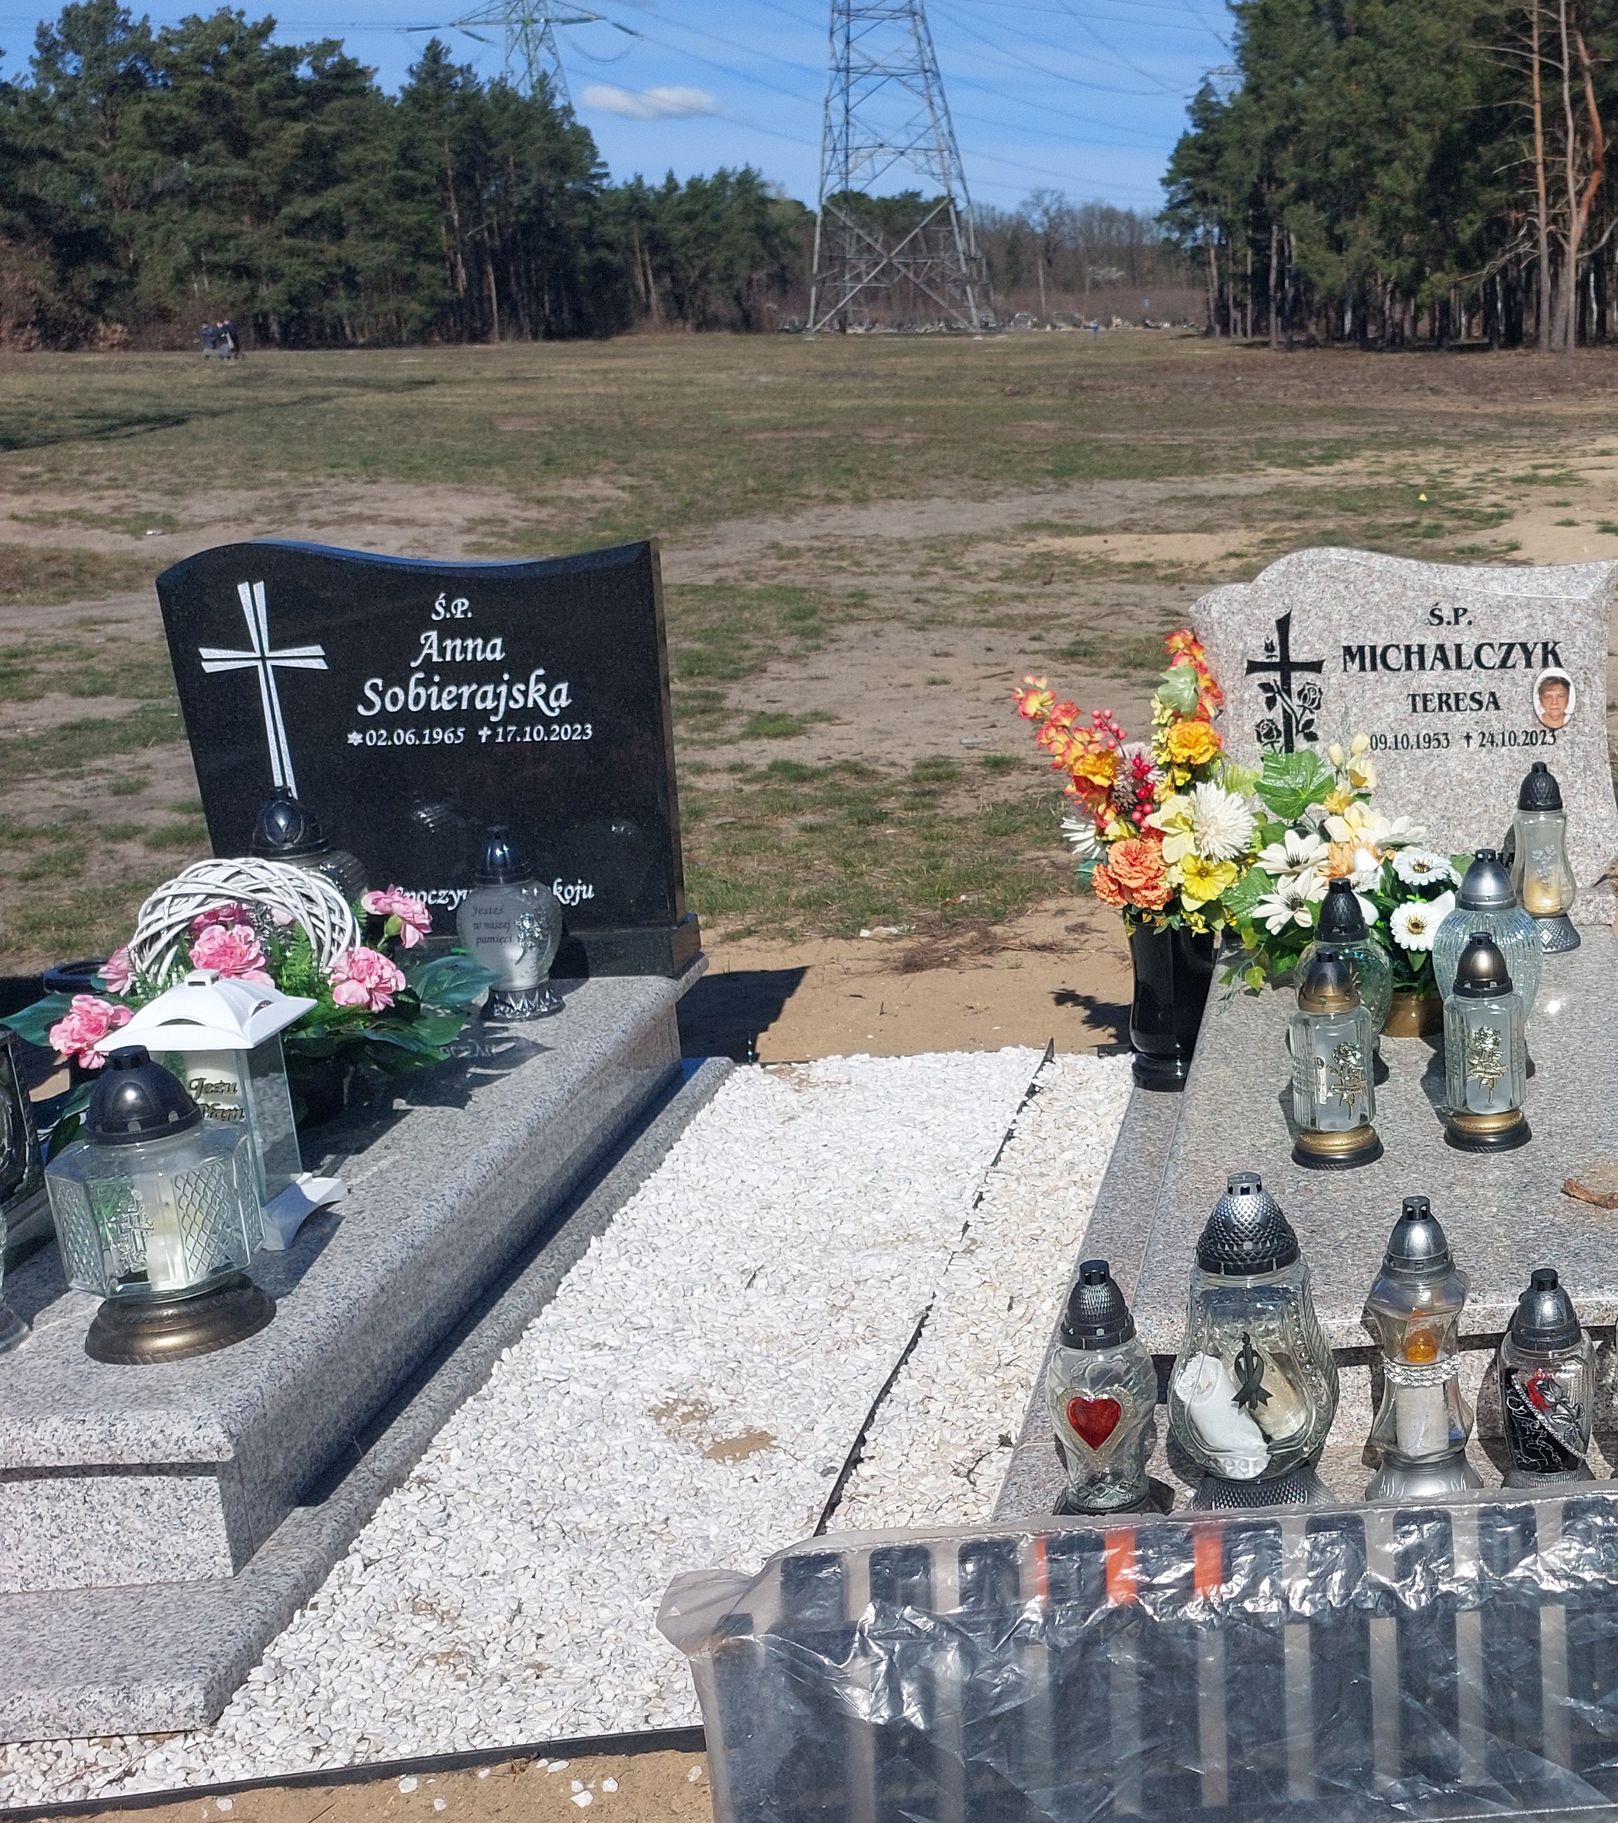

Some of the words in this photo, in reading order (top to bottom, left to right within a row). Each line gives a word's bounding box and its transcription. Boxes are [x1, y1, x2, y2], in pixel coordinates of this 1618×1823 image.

[431, 593, 472, 620] Ś.P.
[1429, 602, 1473, 627] Ś.P.
[410, 630, 506, 668] Anna
[1342, 640, 1564, 673] MICHALCZYK
[357, 668, 572, 721] Sobierajska
[1407, 691, 1501, 714] TERESA
[366, 727, 466, 747] 02.06.1965
[495, 723, 593, 744] 17.10.2023
[1369, 731, 1451, 752] 09.10.1953
[1478, 729, 1558, 749] 24.10.2023
[189, 1077, 239, 1101] Jezu
